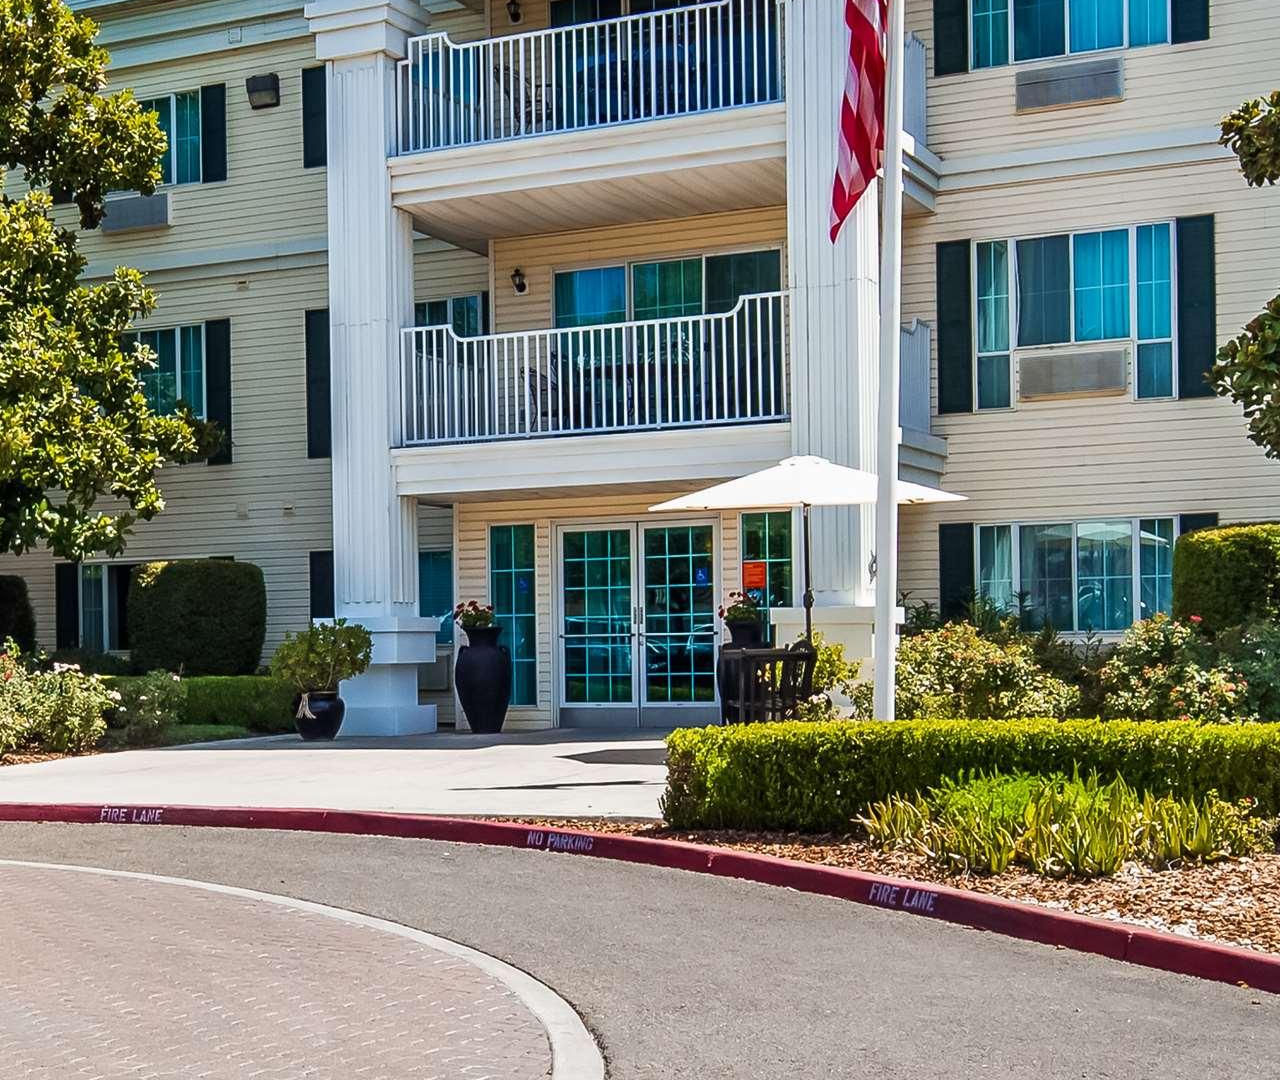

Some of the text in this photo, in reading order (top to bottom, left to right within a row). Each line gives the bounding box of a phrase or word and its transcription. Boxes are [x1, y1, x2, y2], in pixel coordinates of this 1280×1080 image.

[100, 808, 163, 823] FIRE LANE
[527, 830, 594, 851] NO PARKING
[869, 882, 938, 912] FIRE LANE
